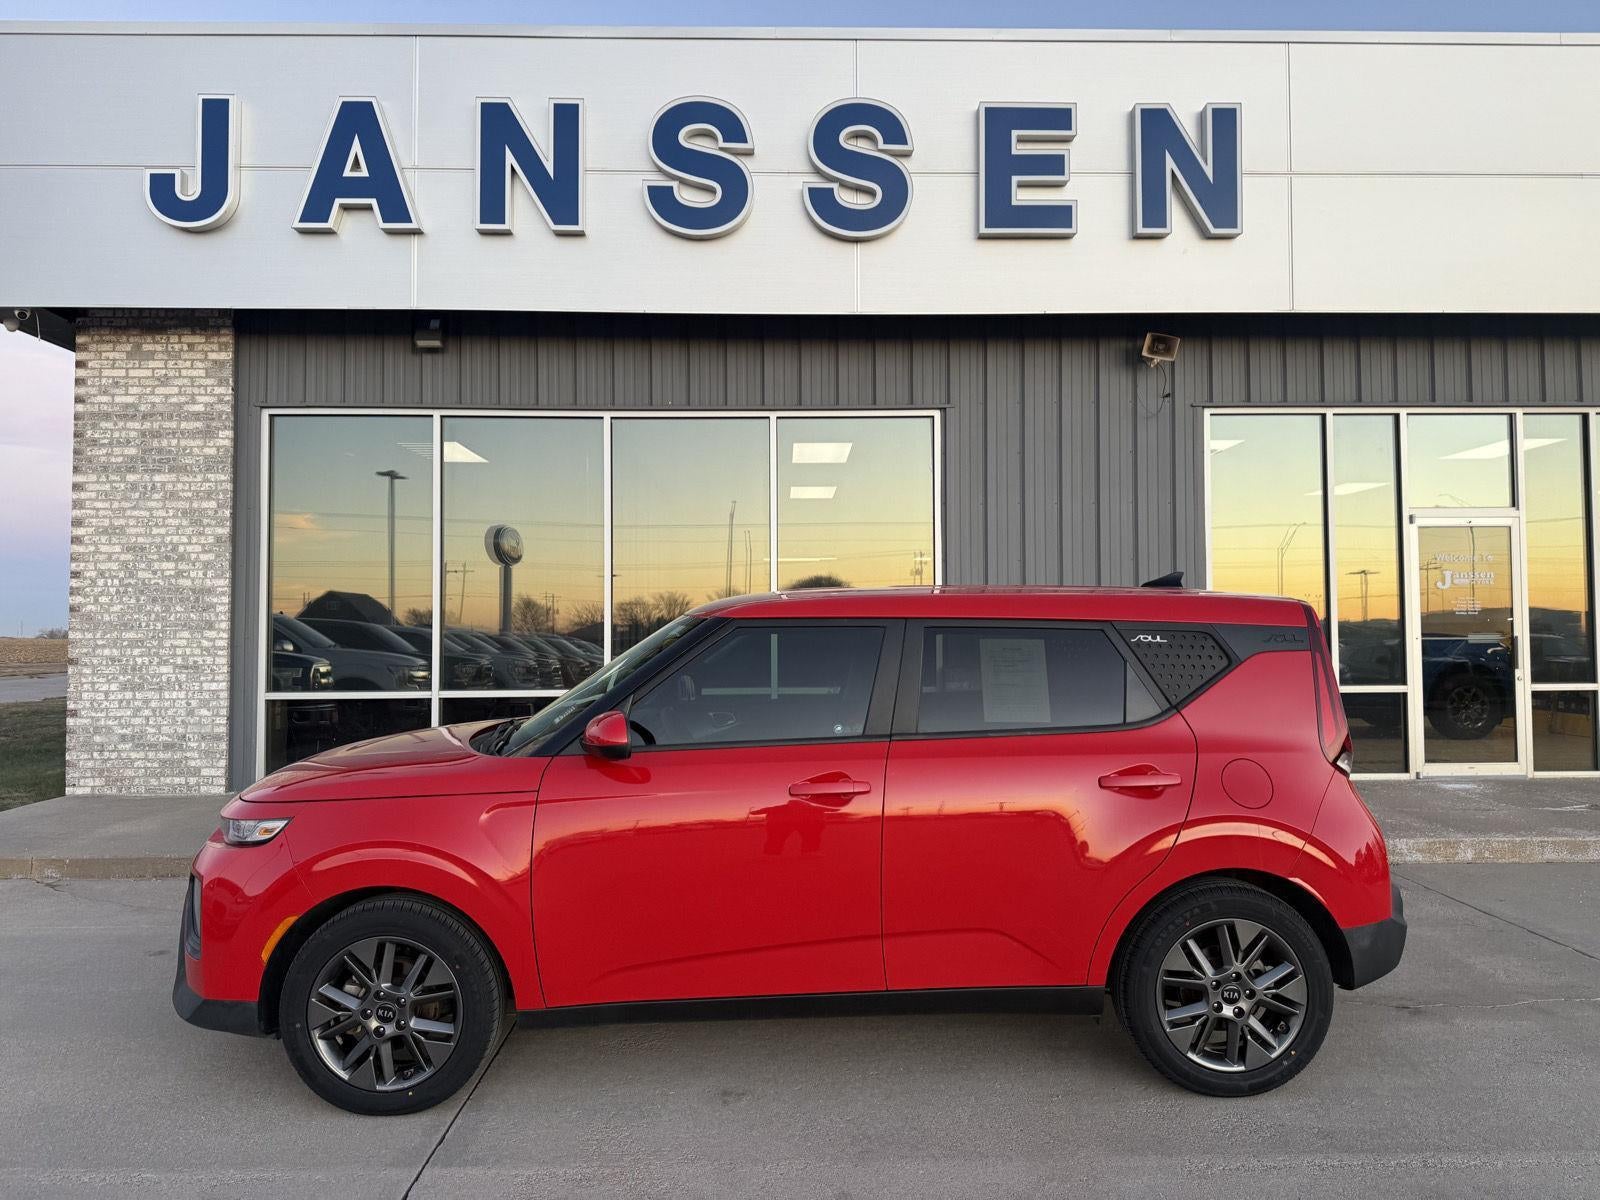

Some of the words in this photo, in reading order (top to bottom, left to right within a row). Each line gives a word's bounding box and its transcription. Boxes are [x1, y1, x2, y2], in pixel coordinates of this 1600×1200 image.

[144, 93, 1243, 239] JANSSEN
[1130, 634, 1168, 643] SOUL
[1224, 991, 1239, 999] KIA
[378, 1009, 394, 1018] KIA
